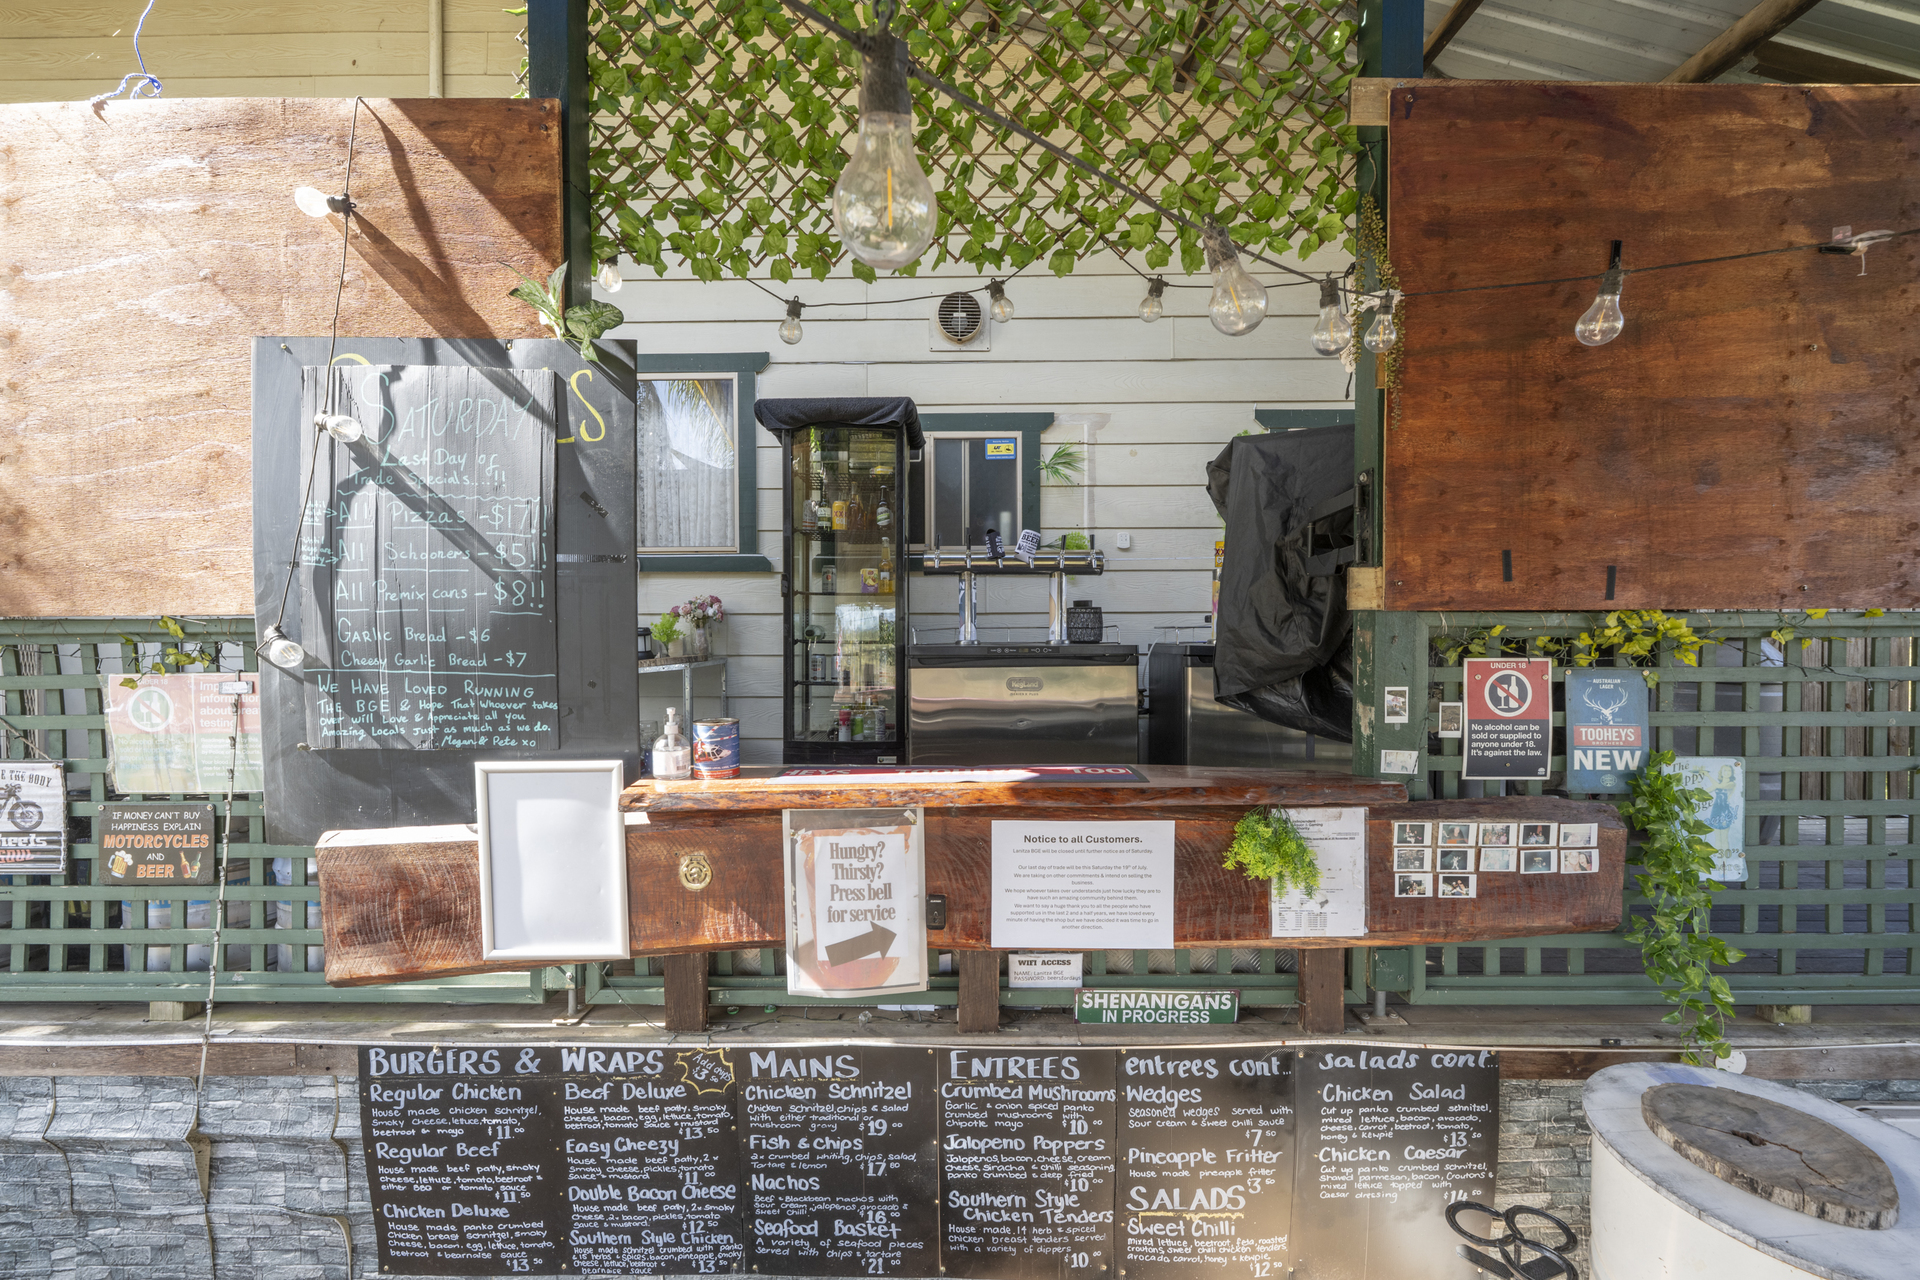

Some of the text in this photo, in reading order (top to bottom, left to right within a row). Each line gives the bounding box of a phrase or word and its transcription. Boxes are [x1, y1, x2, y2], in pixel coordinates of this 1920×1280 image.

[361, 372, 534, 445] SATURDAY
[381, 445, 499, 476] Last Day of
[347, 467, 394, 485] Trade
[339, 501, 466, 523] All Pizzas
[338, 542, 363, 562] All
[388, 542, 470, 560] Schooners
[337, 580, 363, 600] All
[372, 580, 425, 601] Premix
[433, 589, 467, 600] cans
[405, 627, 446, 641] Bread
[341, 650, 487, 670] Cheesy Garlic Bread
[318, 674, 534, 698] WE HAVE LOVED RUNNING
[200, 707, 231, 715] about
[318, 700, 341, 714] THE
[357, 700, 389, 713] BGE
[400, 700, 410, 711] &
[420, 700, 443, 711] Hope
[451, 698, 475, 708] That
[532, 700, 557, 709] takes
[1499, 732, 1531, 741] supplied
[1580, 728, 1635, 741] TOOHEYS
[1485, 749, 1510, 758] against
[1574, 750, 1642, 770] NEW
[1672, 762, 1689, 772] The
[9, 770, 52, 787] THE BODY
[112, 812, 122, 820] IF
[124, 812, 151, 820] MONEY
[155, 812, 180, 820] CAN'T
[112, 823, 159, 831] HAPPINESS
[104, 834, 209, 849] MOTORCYCLES
[1024, 835, 1056, 843] Notice
[1071, 835, 1083, 843] all
[1085, 835, 1142, 843] Customers.
[147, 853, 165, 861] AND
[829, 841, 886, 863] Hungry?
[137, 864, 174, 878] BEER
[832, 863, 884, 883] Thirsty?
[830, 883, 892, 902] Press bell
[827, 905, 896, 923] for service
[1082, 994, 1231, 1010] SHENANIGANS
[1103, 1010, 1210, 1023] IN PROGRESS
[370, 1048, 664, 1076] BURGERS & WRAPS
[692, 1053, 716, 1070] Add
[750, 1051, 860, 1079] MAINS
[950, 1050, 1081, 1080] ENTREES
[1125, 1055, 1219, 1079] entrees
[370, 1083, 522, 1109] Regular Chicken
[565, 1083, 687, 1101] Beef Deluxe
[745, 1082, 912, 1101] Chicken Schnitzel
[941, 1083, 1115, 1102] Crumbed Mushrooms
[1126, 1085, 1202, 1109] Wedges
[1323, 1083, 1466, 1101] Chicken Salad
[566, 1137, 680, 1160] Easy Cheezy
[750, 1136, 791, 1150] Fish
[798, 1137, 810, 1150] &
[1033, 1136, 1106, 1156] Poppers
[375, 1142, 502, 1164] Regular Beef
[1128, 1148, 1283, 1174] Pineapple Fritter
[1319, 1146, 1467, 1162] Chicken Caesar
[1129, 1167, 1276, 1178] House made pineapple fritter
[752, 1175, 820, 1191] Nachos
[568, 1185, 736, 1201] Double Bacon Cheese
[949, 1190, 1081, 1211] Southern Style
[1126, 1186, 1246, 1210] SALADS
[383, 1204, 510, 1219] Chicken Deluxe
[964, 1208, 1113, 1223] Chicken Tenders
[755, 1220, 902, 1238] Seafood Basket
[1127, 1219, 1236, 1236] Sweet Chilli
[569, 1231, 734, 1247] Southern Style Chicken
